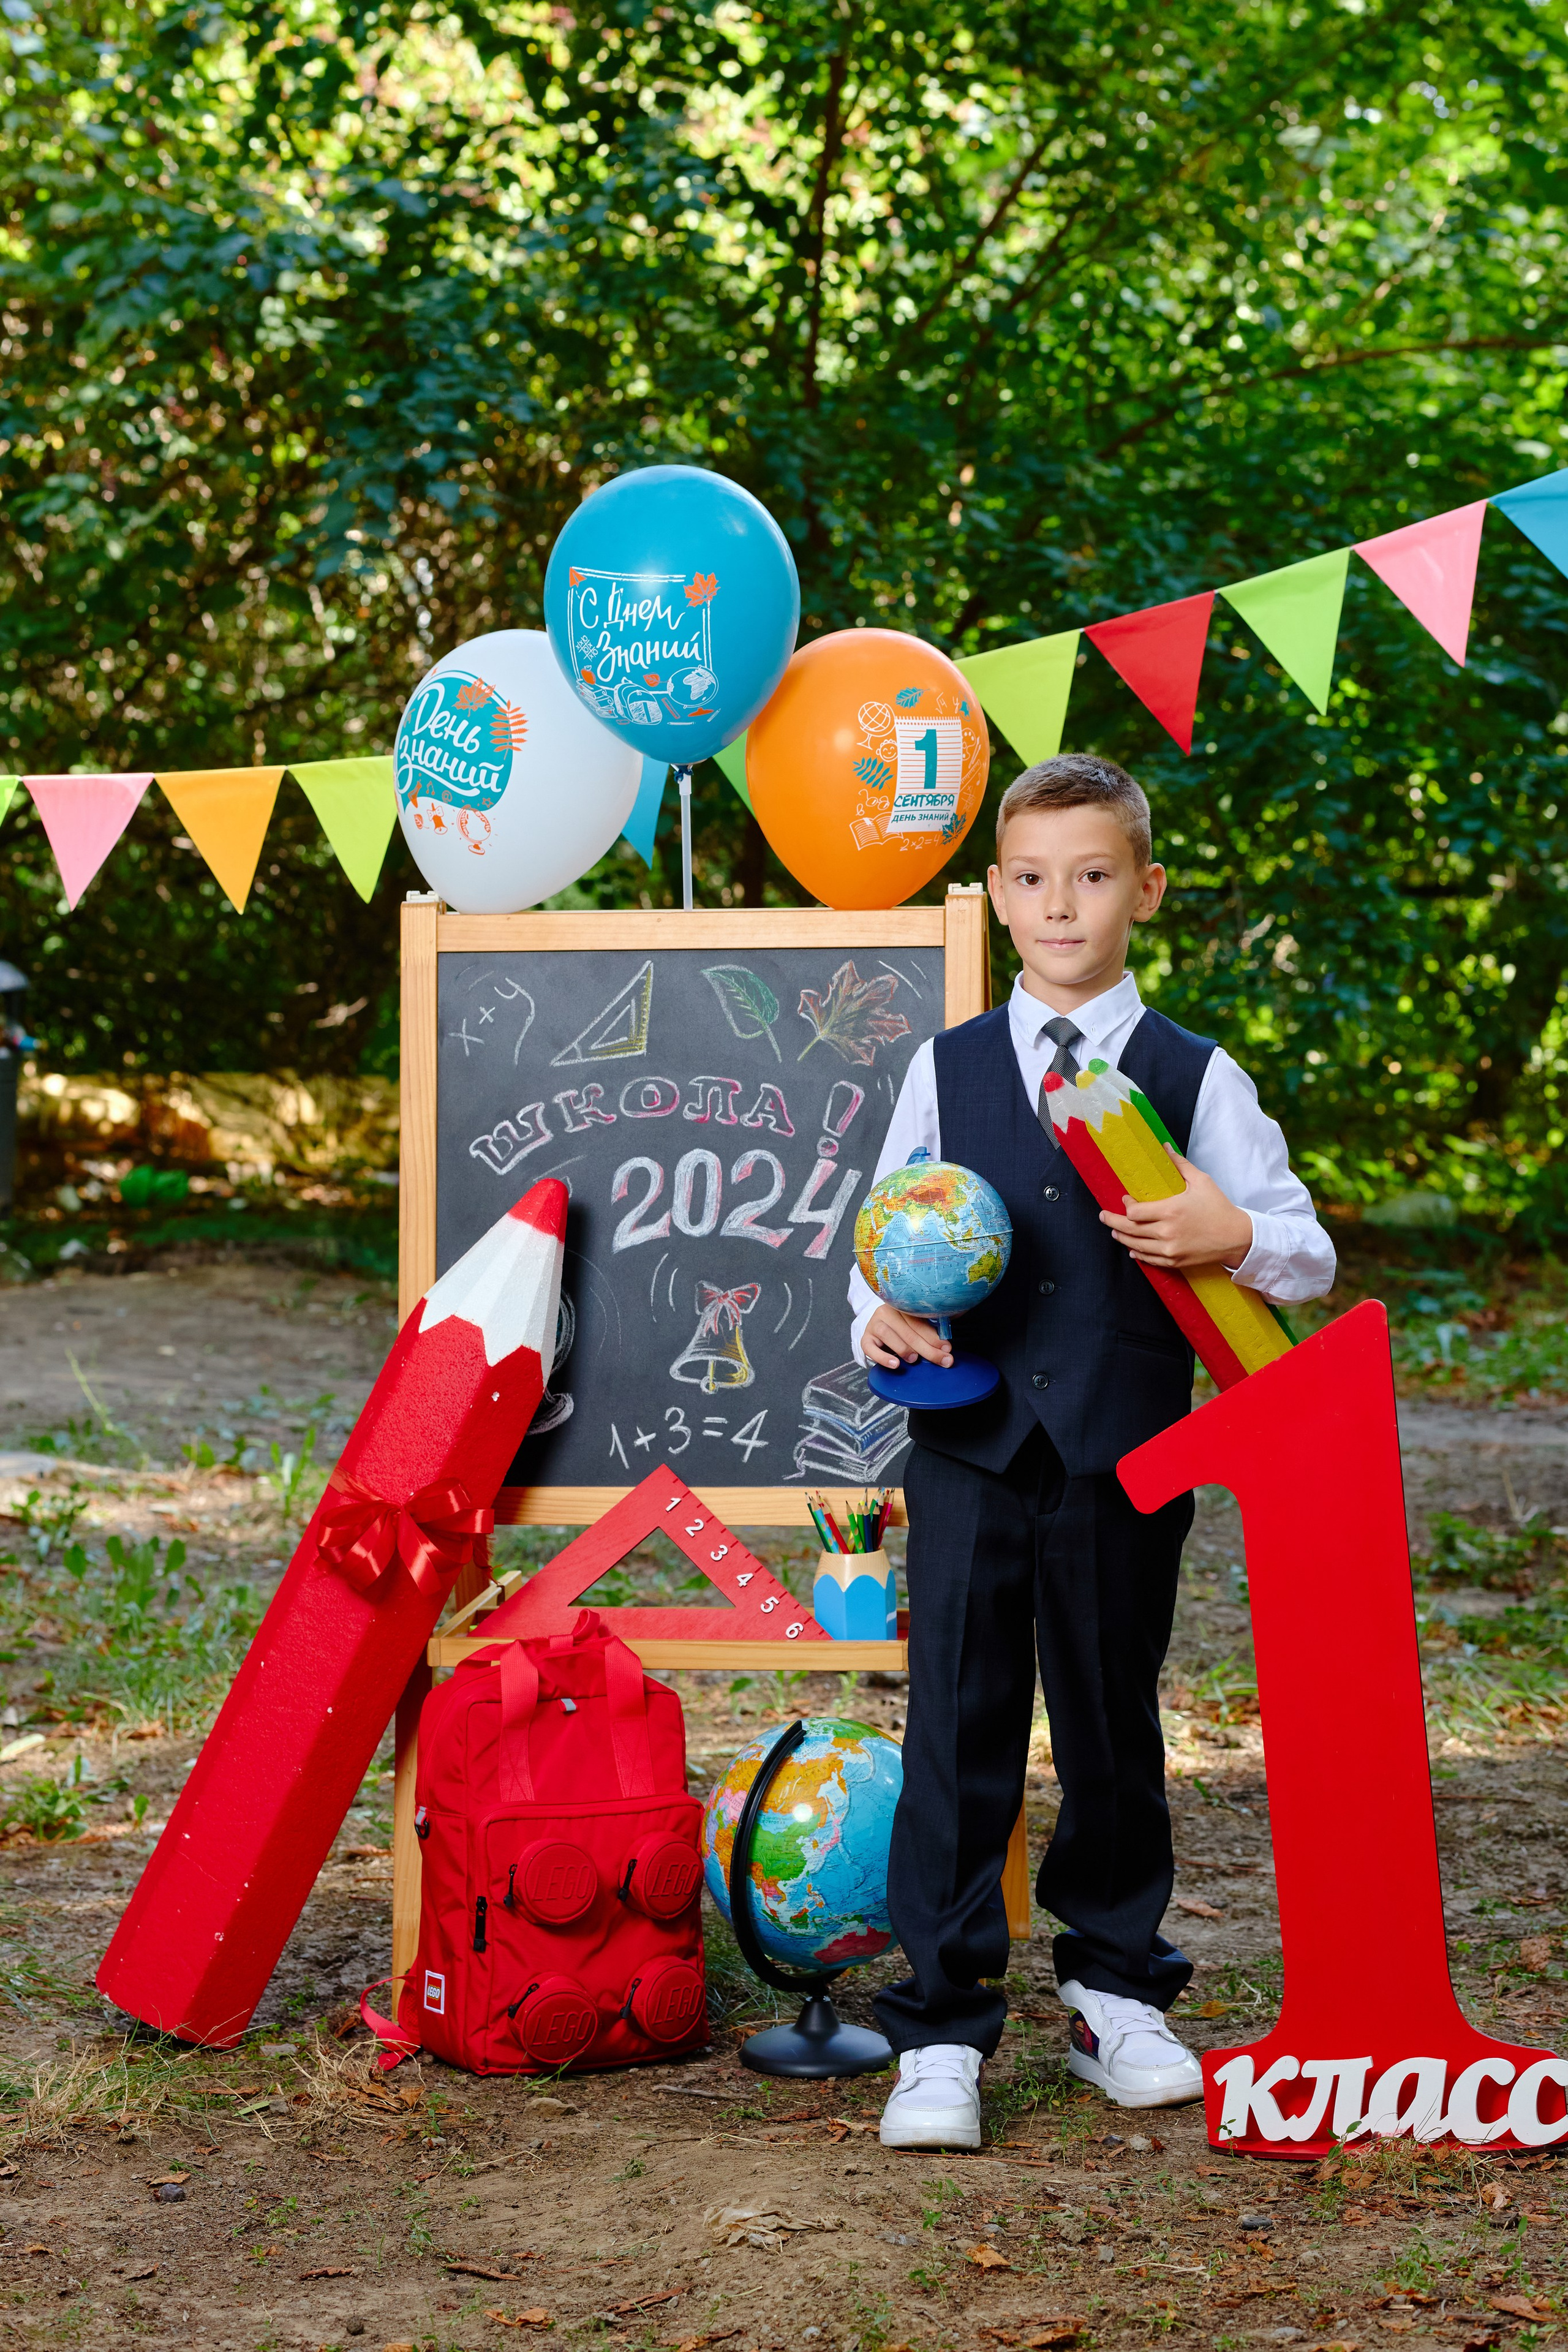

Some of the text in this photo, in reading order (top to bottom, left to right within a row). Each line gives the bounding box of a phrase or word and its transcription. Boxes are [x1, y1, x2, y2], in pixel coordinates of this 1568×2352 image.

[579, 582, 685, 631] С Днем
[595, 631, 703, 682] Знаний
[412, 682, 481, 754] День
[914, 729, 938, 790] 1
[891, 812, 949, 824] ДЕНЬ ЗНАНИЙ
[894, 794, 955, 807] СЕНТЯБРЯ
[611, 1148, 862, 1259] 2024
[665, 1496, 804, 1640] 1 2 3 4 5 6
[533, 1864, 594, 1901] LEGO
[648, 1862, 699, 1898] LEGO
[427, 1985, 440, 1999] LEGO
[653, 1984, 703, 2024] LEGO
[532, 2011, 592, 2046] LEGO
